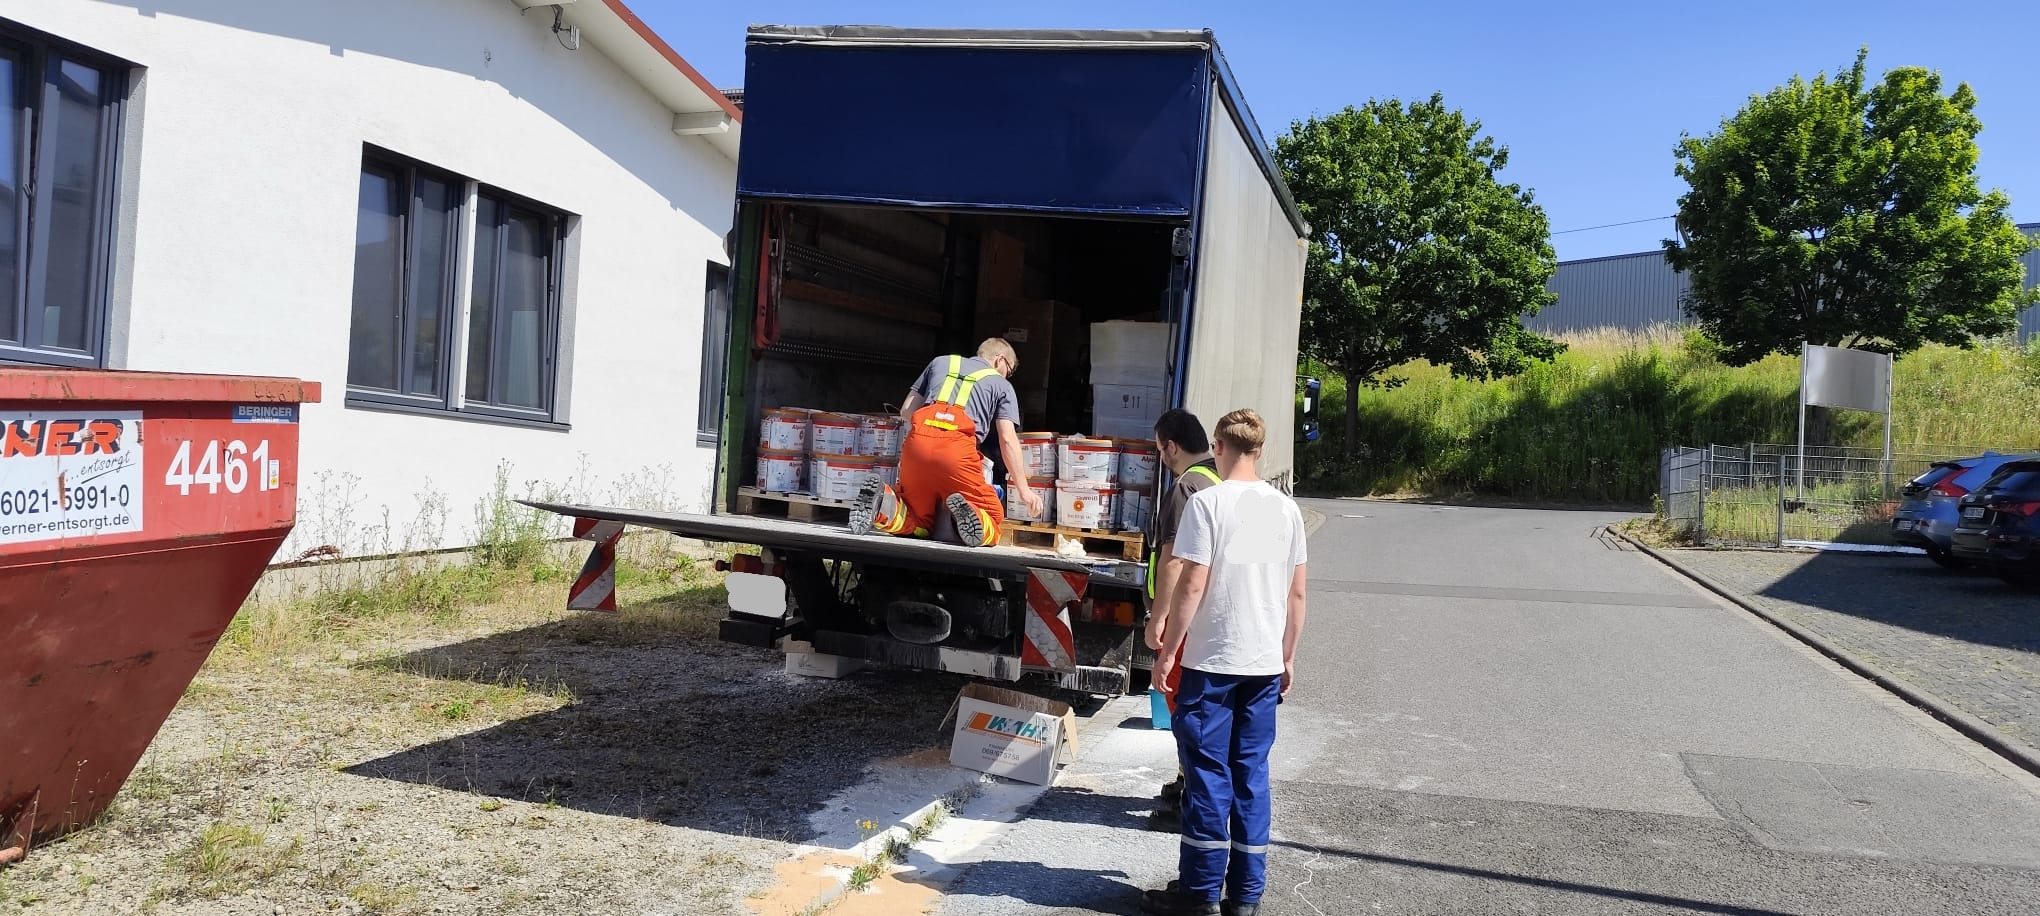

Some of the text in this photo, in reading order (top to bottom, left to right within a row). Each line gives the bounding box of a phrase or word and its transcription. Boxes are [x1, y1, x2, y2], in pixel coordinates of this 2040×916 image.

[238, 405, 292, 417] BERINGER
[0, 418, 124, 458] NER
[164, 439, 269, 496] 4461
[0, 514, 130, 537] erner-entsorgt.de
